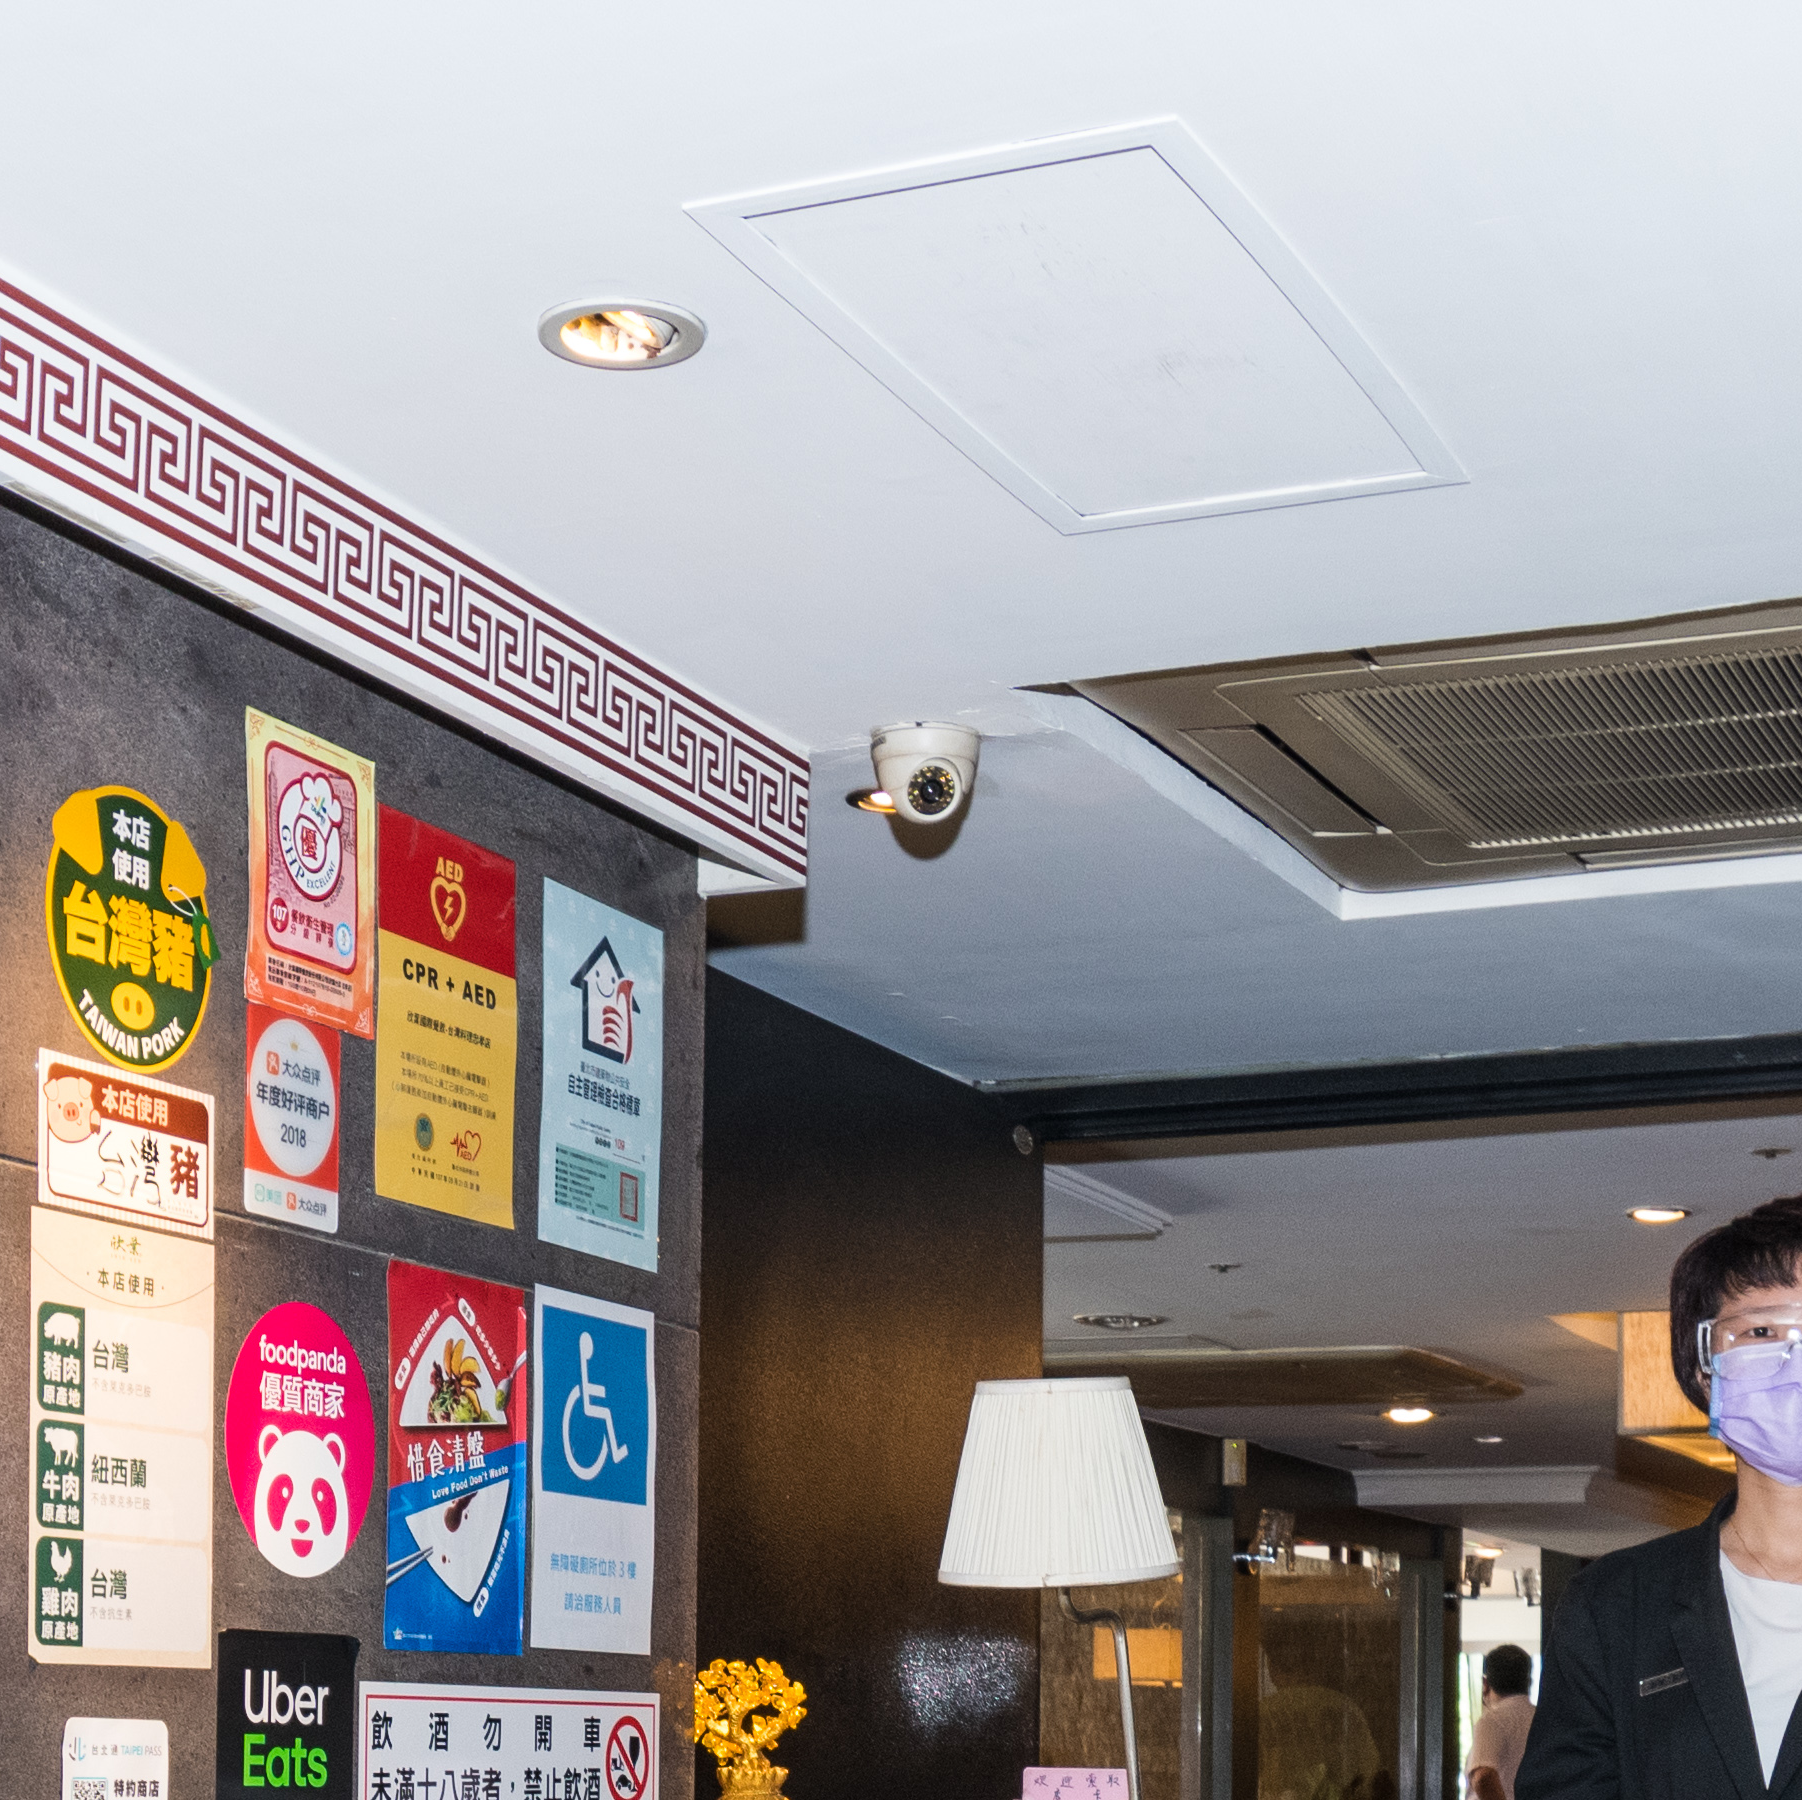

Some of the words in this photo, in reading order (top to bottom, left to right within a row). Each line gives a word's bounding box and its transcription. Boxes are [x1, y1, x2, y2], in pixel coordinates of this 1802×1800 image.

[112, 809, 151, 851] 本店
[112, 848, 151, 890] 使用
[282, 825, 305, 881] GHP
[435, 856, 464, 883] AED
[306, 861, 335, 889] EXCELLENT
[272, 904, 287, 921] 107
[63, 880, 195, 992] 台灣豬
[402, 958, 439, 990] CPR
[462, 980, 497, 1010] AED
[78, 988, 140, 1060] TAIWAN
[140, 1016, 185, 1060] PORK
[282, 1060, 321, 1087] 大众点评
[101, 1084, 169, 1127] 本店使用
[256, 1081, 330, 1121] 年度好评商户
[280, 1123, 306, 1148] 2018
[97, 1268, 154, 1298] 本店使用
[43, 1351, 80, 1385] 豬肉
[92, 1339, 129, 1373] 台灣
[259, 1334, 346, 1375] foodpanda
[43, 1384, 80, 1408] 原產地
[259, 1371, 345, 1419] 優質商家
[91, 1454, 147, 1489] 紐西蘭
[407, 1430, 486, 1483] 惜食清盤
[42, 1470, 79, 1502] 牛肉
[432, 1487, 449, 1500] Love
[451, 1478, 468, 1493] Food
[469, 1470, 488, 1487] Don't
[489, 1465, 509, 1479] Waste
[42, 1503, 79, 1525] 原產地
[91, 1568, 128, 1599] 台灣
[41, 1586, 78, 1618] 雞肉
[41, 1620, 78, 1641] 原產地
[244, 1669, 329, 1725] Uber
[371, 1711, 601, 1753] 飲酒勿開車
[121, 1744, 143, 1756] TAIPEI
[145, 1745, 162, 1756] PASS
[243, 1734, 328, 1788] Eats
[114, 1779, 160, 1798] 特約商店
